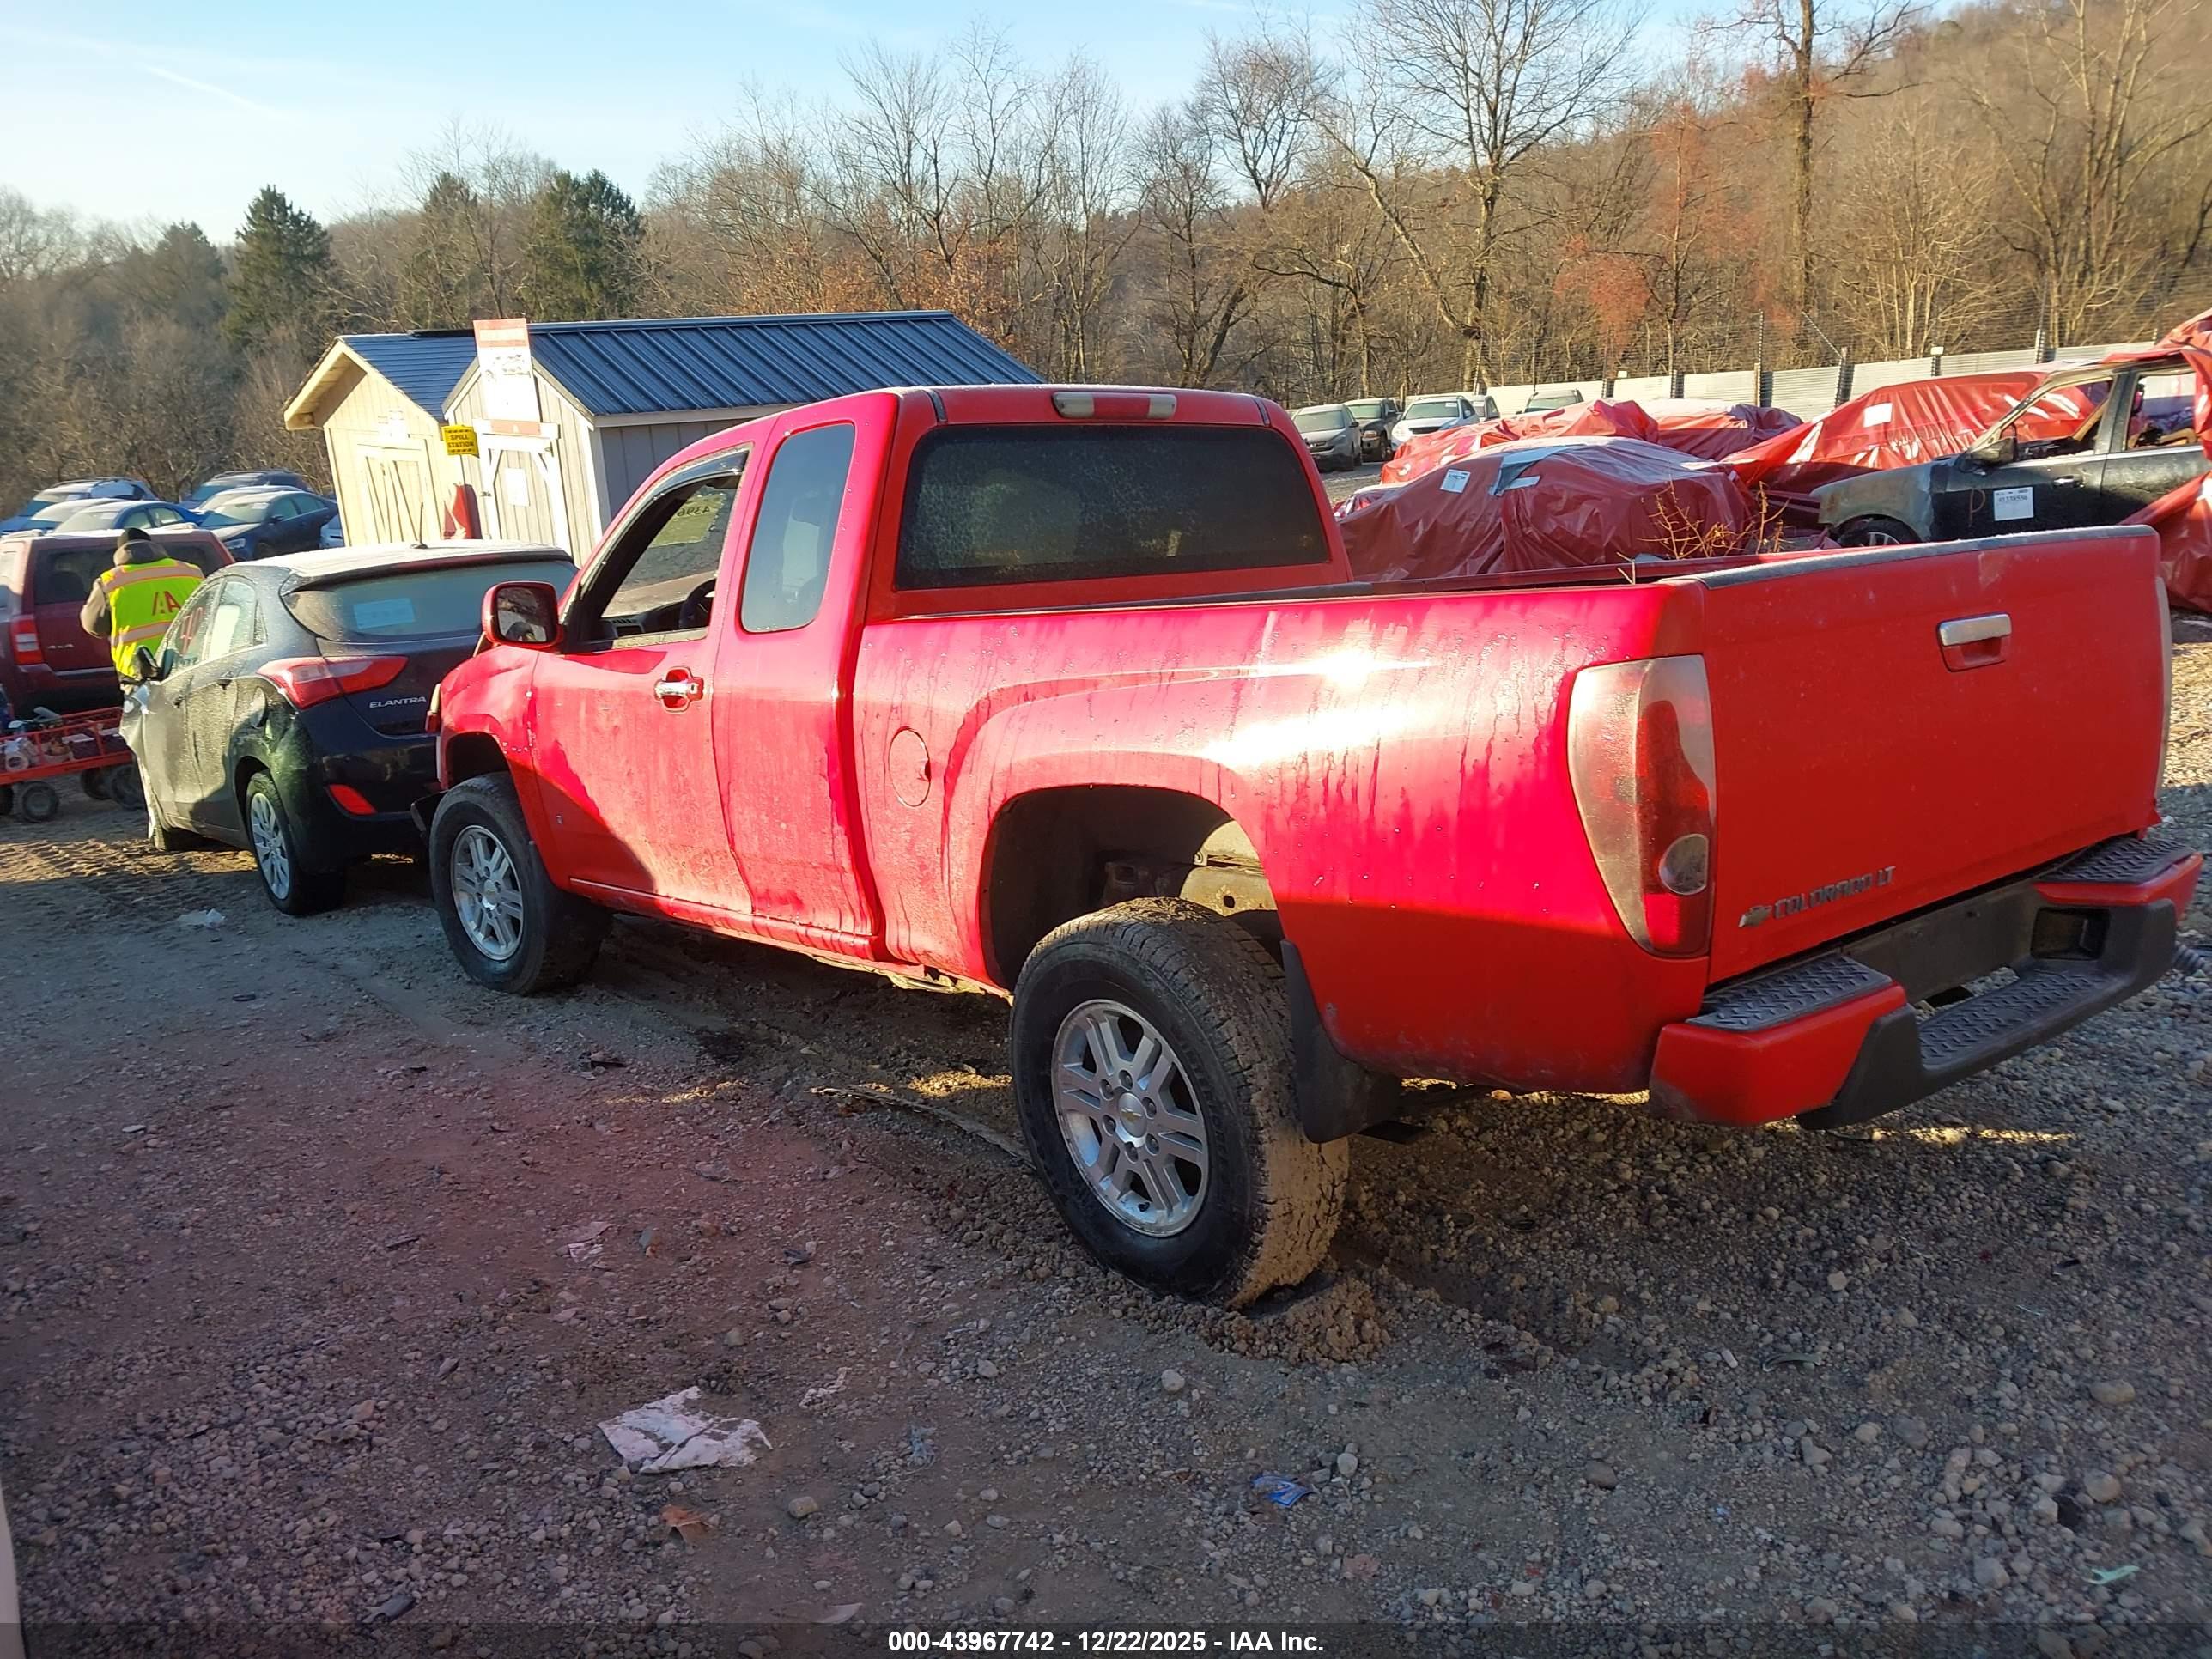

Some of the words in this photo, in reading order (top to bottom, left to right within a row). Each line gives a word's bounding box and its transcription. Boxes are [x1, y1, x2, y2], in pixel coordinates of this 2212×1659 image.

[369, 696, 427, 708] ELANTRA
[1774, 873, 1872, 918] COLORADO
[1876, 865, 1896, 886] LT
